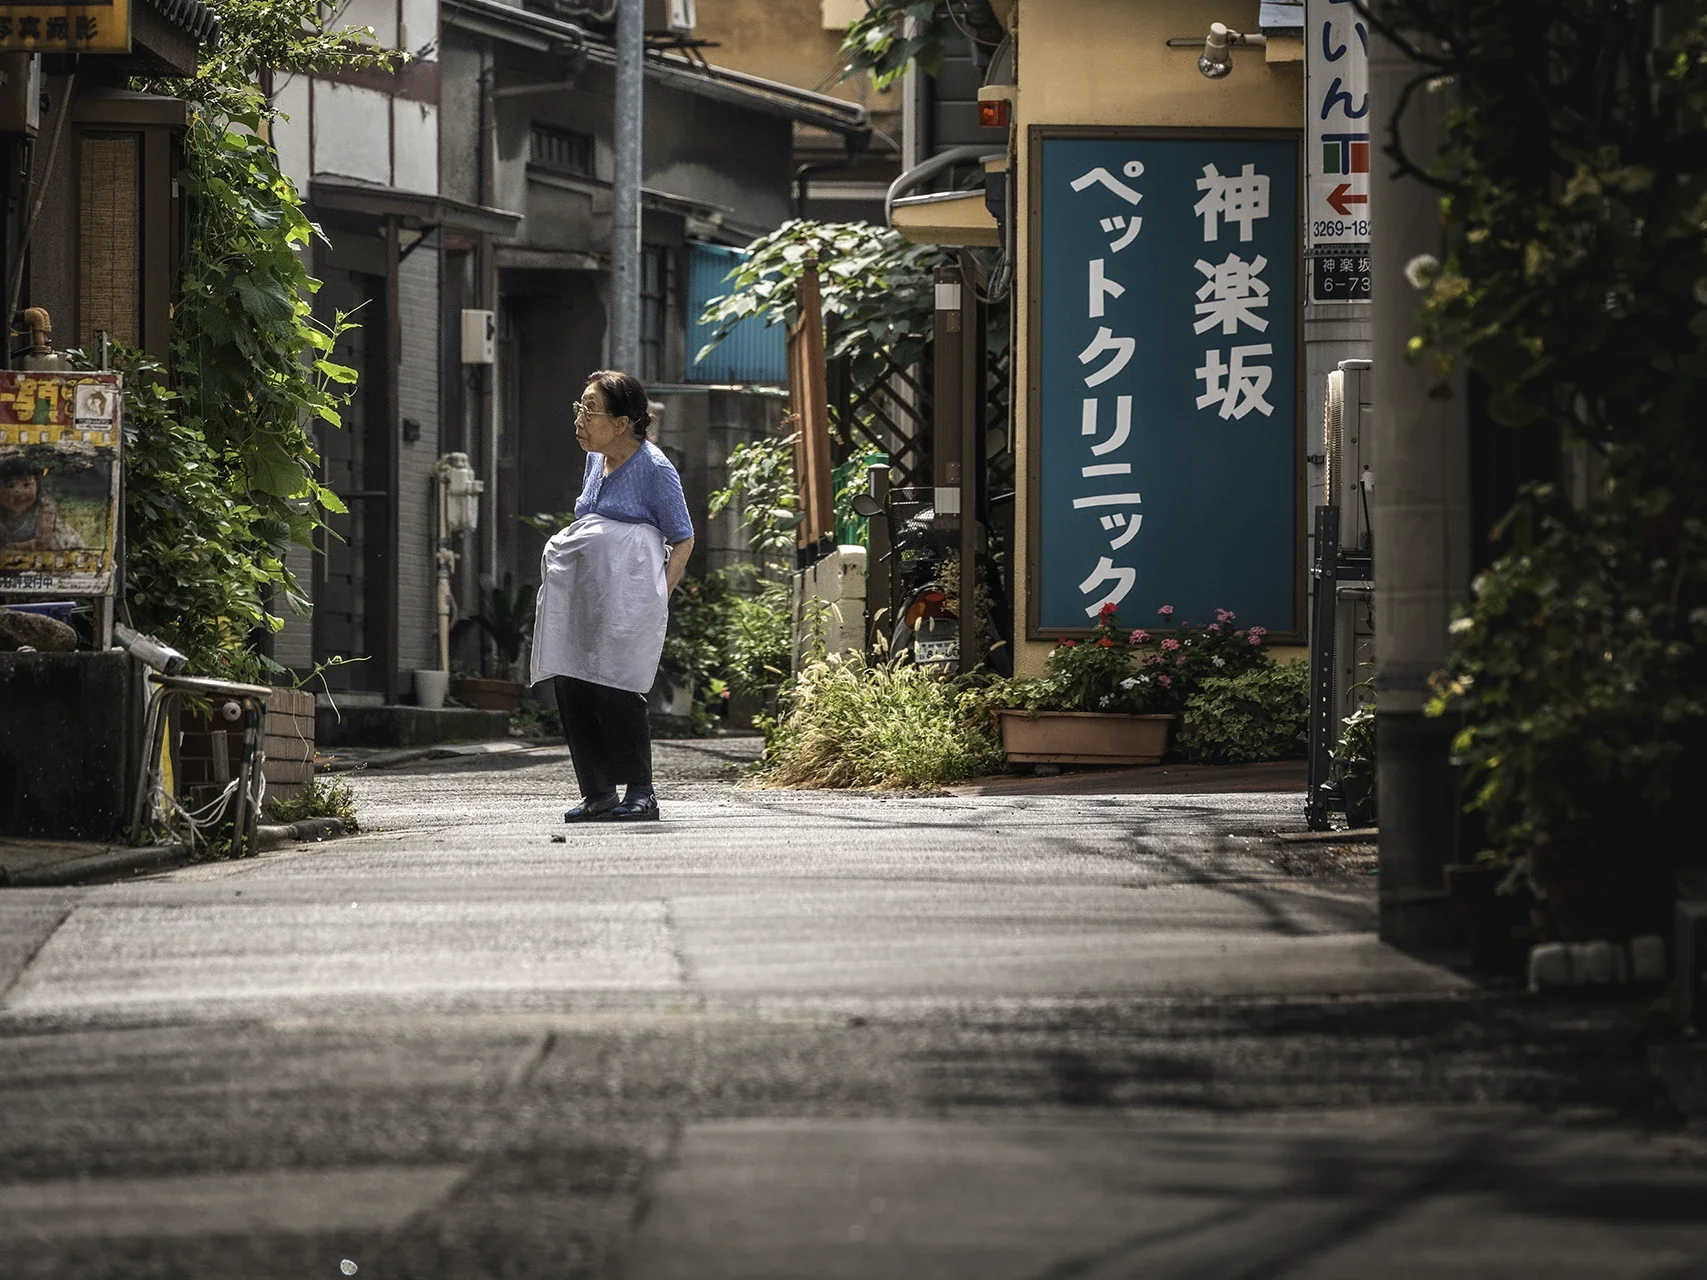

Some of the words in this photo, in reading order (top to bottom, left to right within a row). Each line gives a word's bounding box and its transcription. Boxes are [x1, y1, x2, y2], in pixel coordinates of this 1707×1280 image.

[1193, 162, 1275, 421] 神楽坂
[1322, 258, 1372, 273] 神楽坂
[1323, 277, 1371, 292] 6-73
[1070, 160, 1145, 619] ペットクリニック
